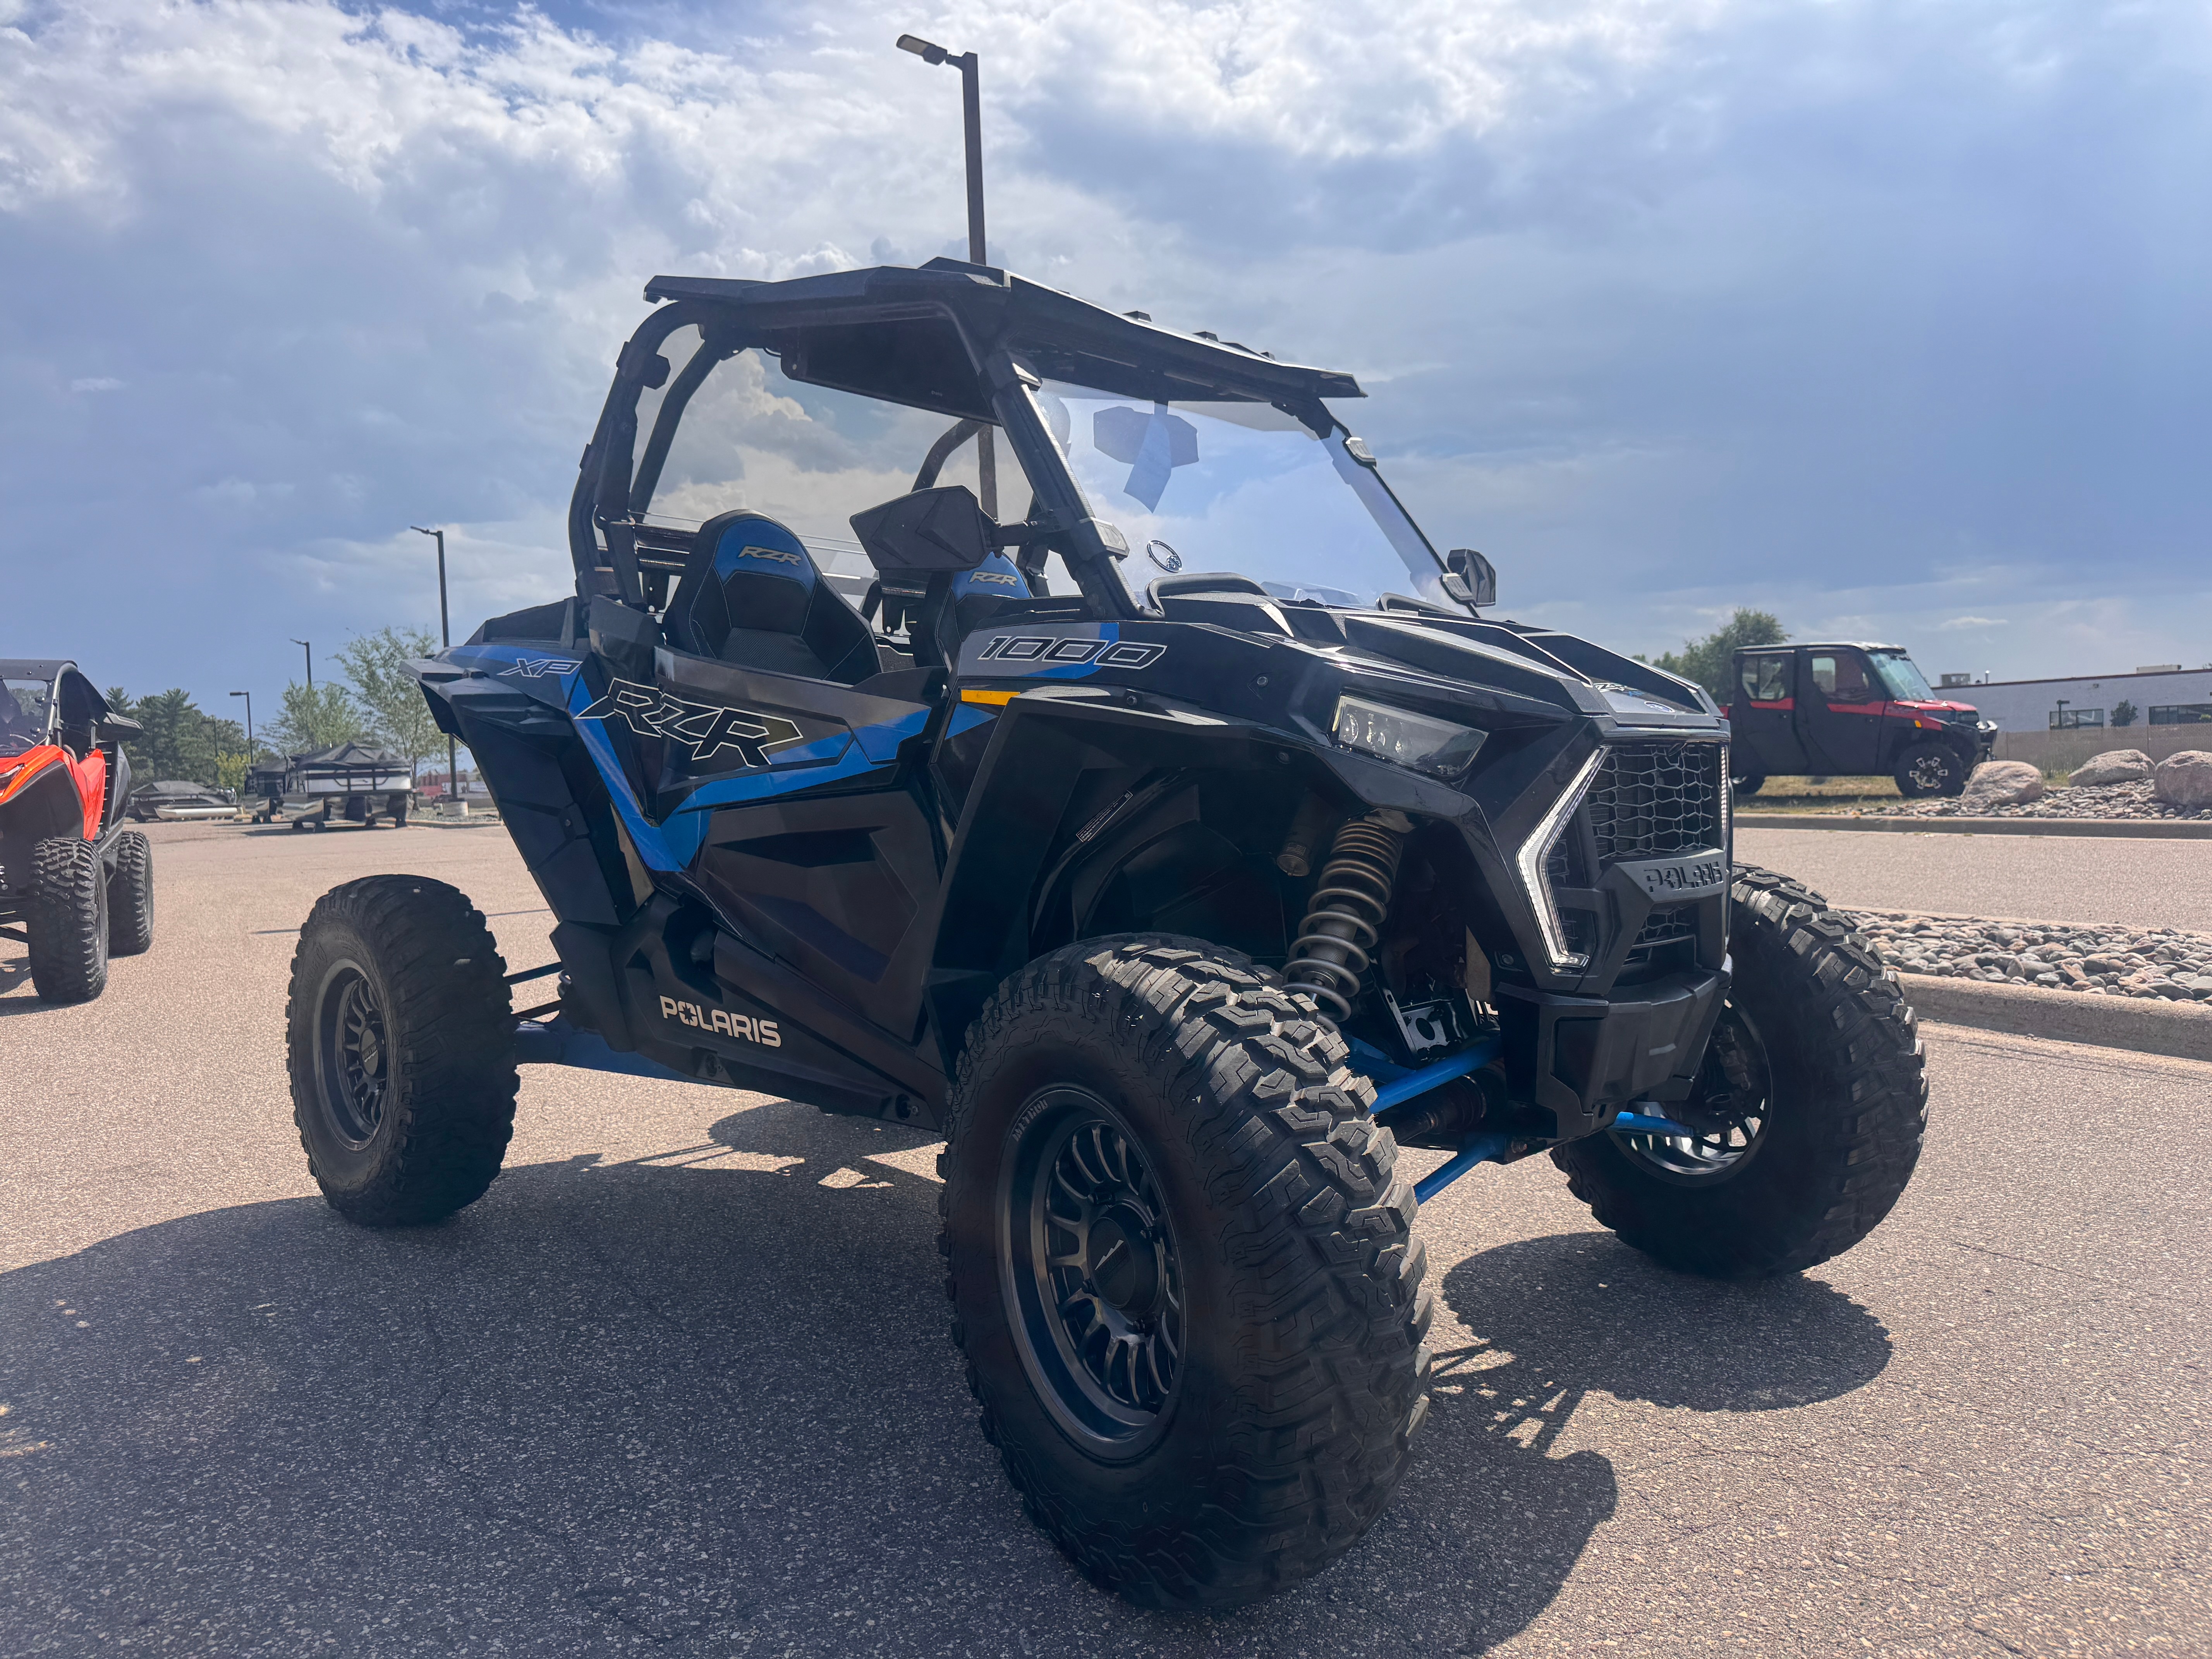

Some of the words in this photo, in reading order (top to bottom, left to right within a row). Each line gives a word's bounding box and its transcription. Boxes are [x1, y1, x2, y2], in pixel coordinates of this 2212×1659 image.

[738, 546, 802, 566] RZR
[969, 572, 1017, 586] RZR
[496, 658, 583, 678] XP
[977, 635, 1168, 670] 1000
[574, 677, 804, 768] RZR
[1644, 861, 1724, 893] POLARIS
[659, 995, 781, 1047] POLARIS
